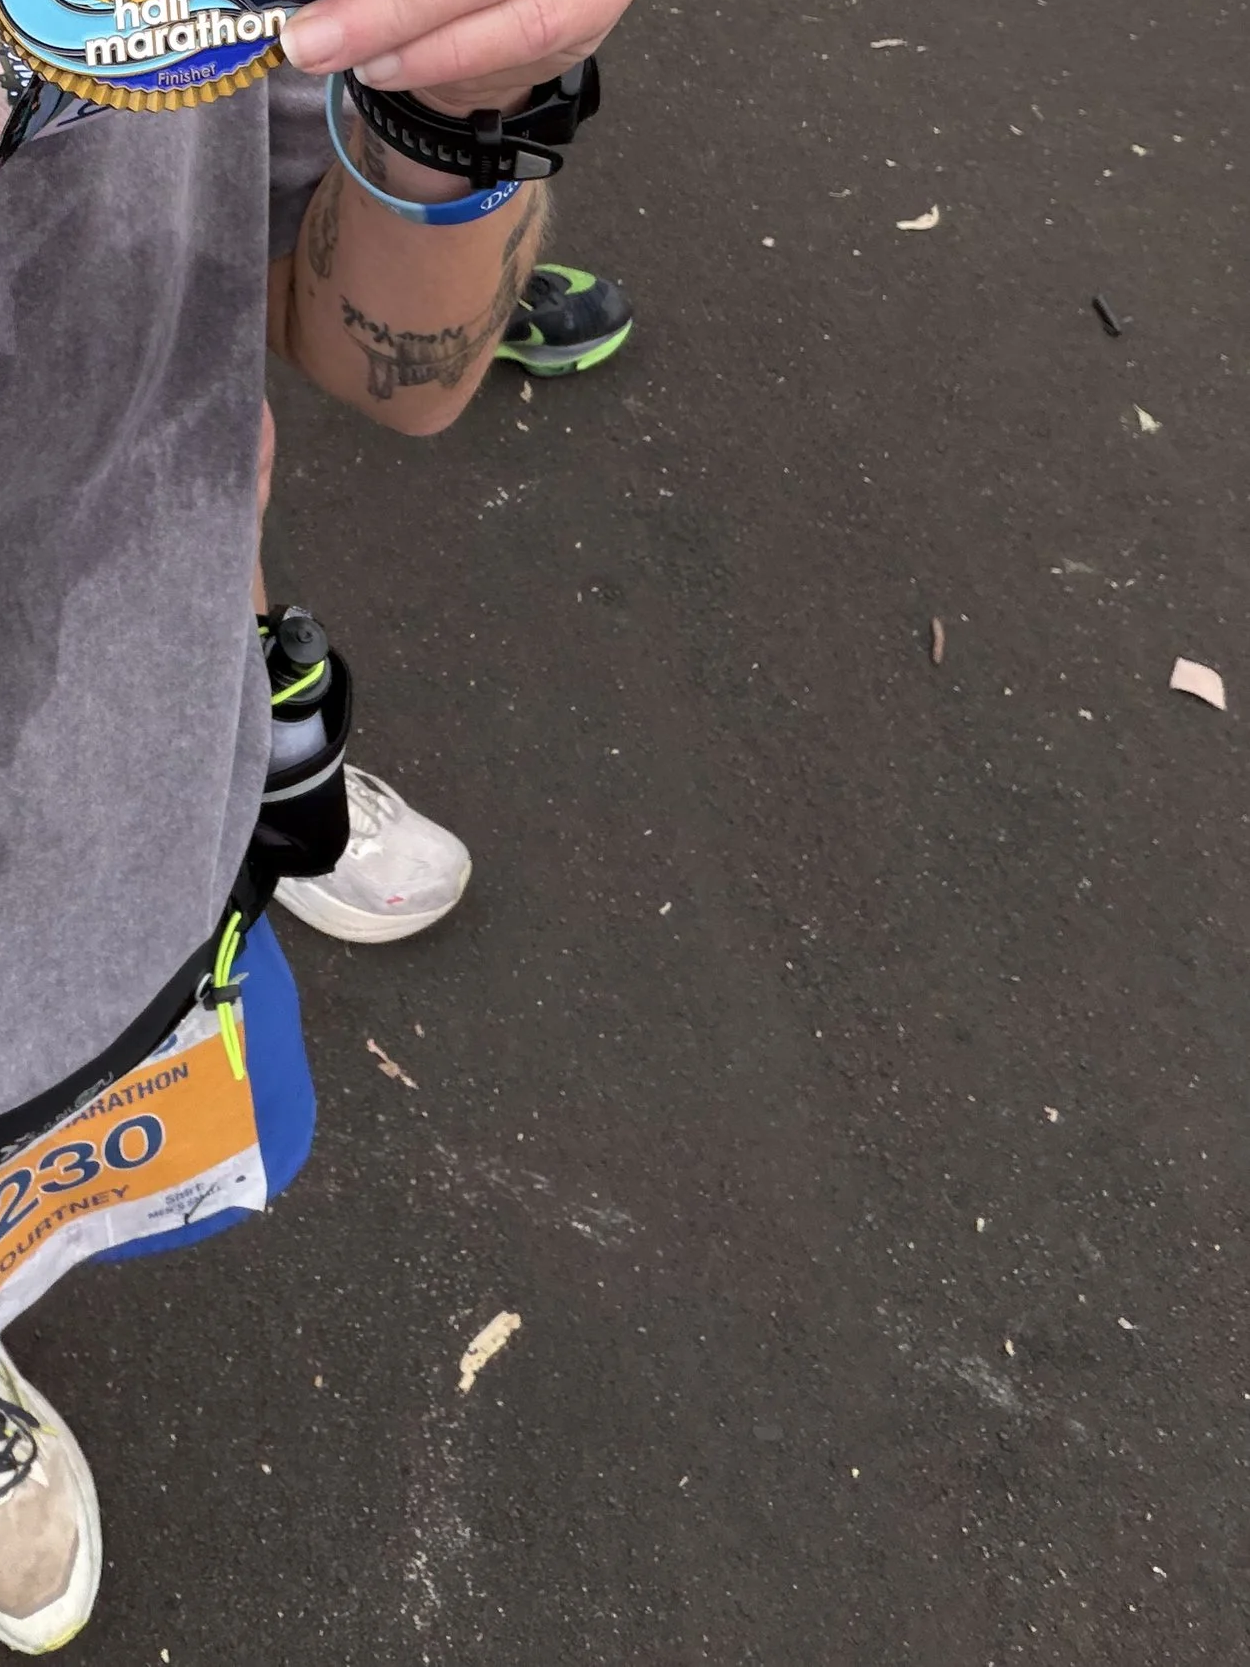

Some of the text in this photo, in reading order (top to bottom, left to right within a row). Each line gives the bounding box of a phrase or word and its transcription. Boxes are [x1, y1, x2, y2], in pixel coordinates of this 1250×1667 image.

[85, 6, 288, 67] marathon
[157, 61, 218, 87] Finisher
[63, 1061, 190, 1131] ARATHON
